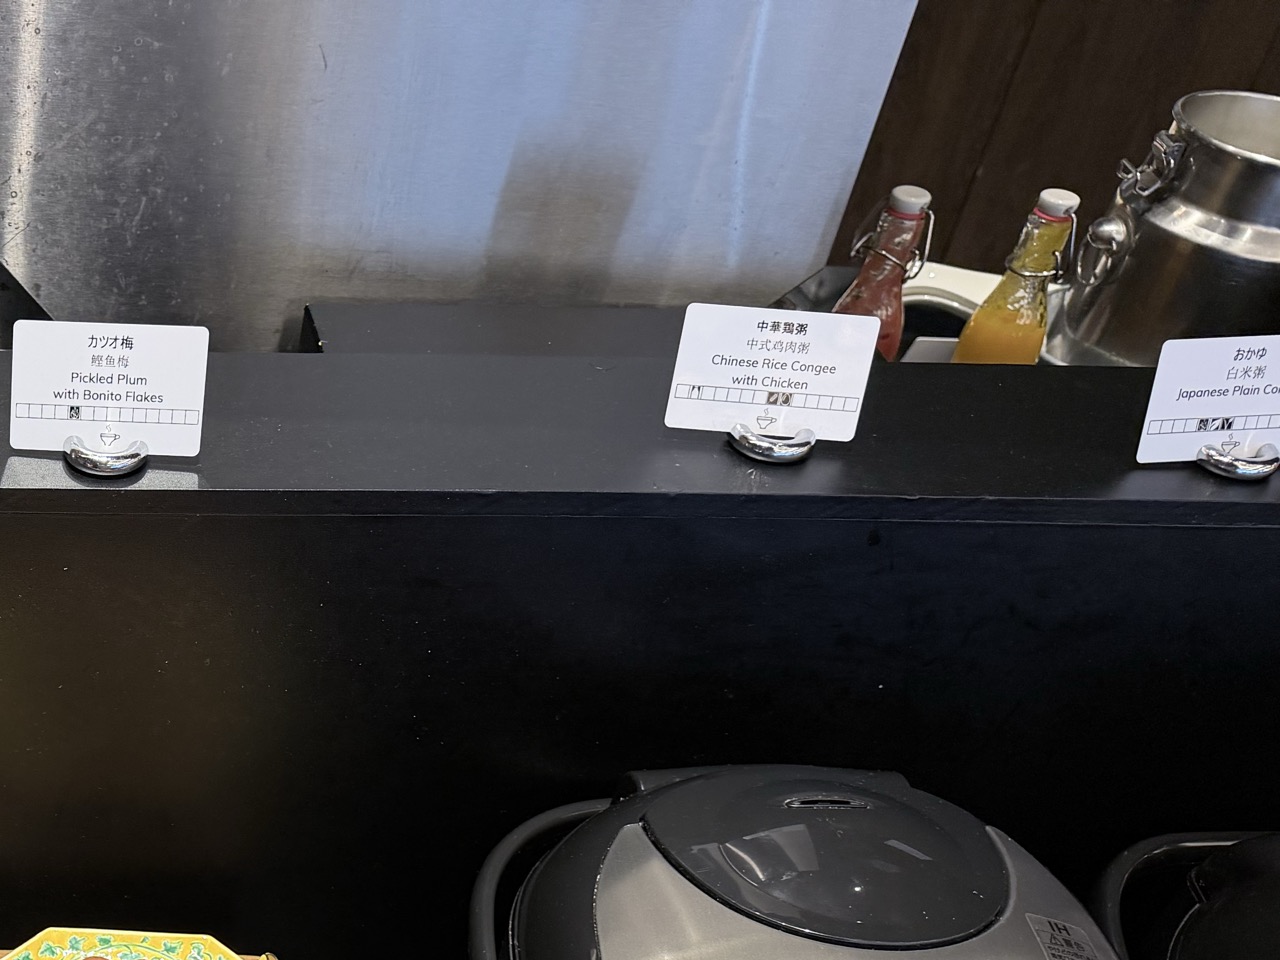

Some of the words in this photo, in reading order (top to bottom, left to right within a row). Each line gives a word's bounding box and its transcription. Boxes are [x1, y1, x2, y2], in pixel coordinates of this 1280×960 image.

[757, 320, 808, 336] 中華鶏粥
[88, 334, 134, 350] カツオ梅
[746, 338, 811, 355] 中式鸡肉粥
[1233, 346, 1267, 361] おかゆ
[711, 354, 759, 369] Chinese
[762, 357, 788, 371] Rice
[791, 360, 837, 376] Congee
[1226, 365, 1267, 380] 白米粥
[71, 372, 114, 385] Pickled
[117, 373, 148, 386] Plum
[732, 375, 758, 387] with
[761, 376, 809, 391] Chicken
[53, 389, 80, 401] with
[83, 389, 122, 402] Bonito
[125, 391, 164, 403] Flakes
[1176, 387, 1230, 401] Japanese
[1232, 385, 1260, 397] Plain
[1047, 920, 1071, 937] IH
